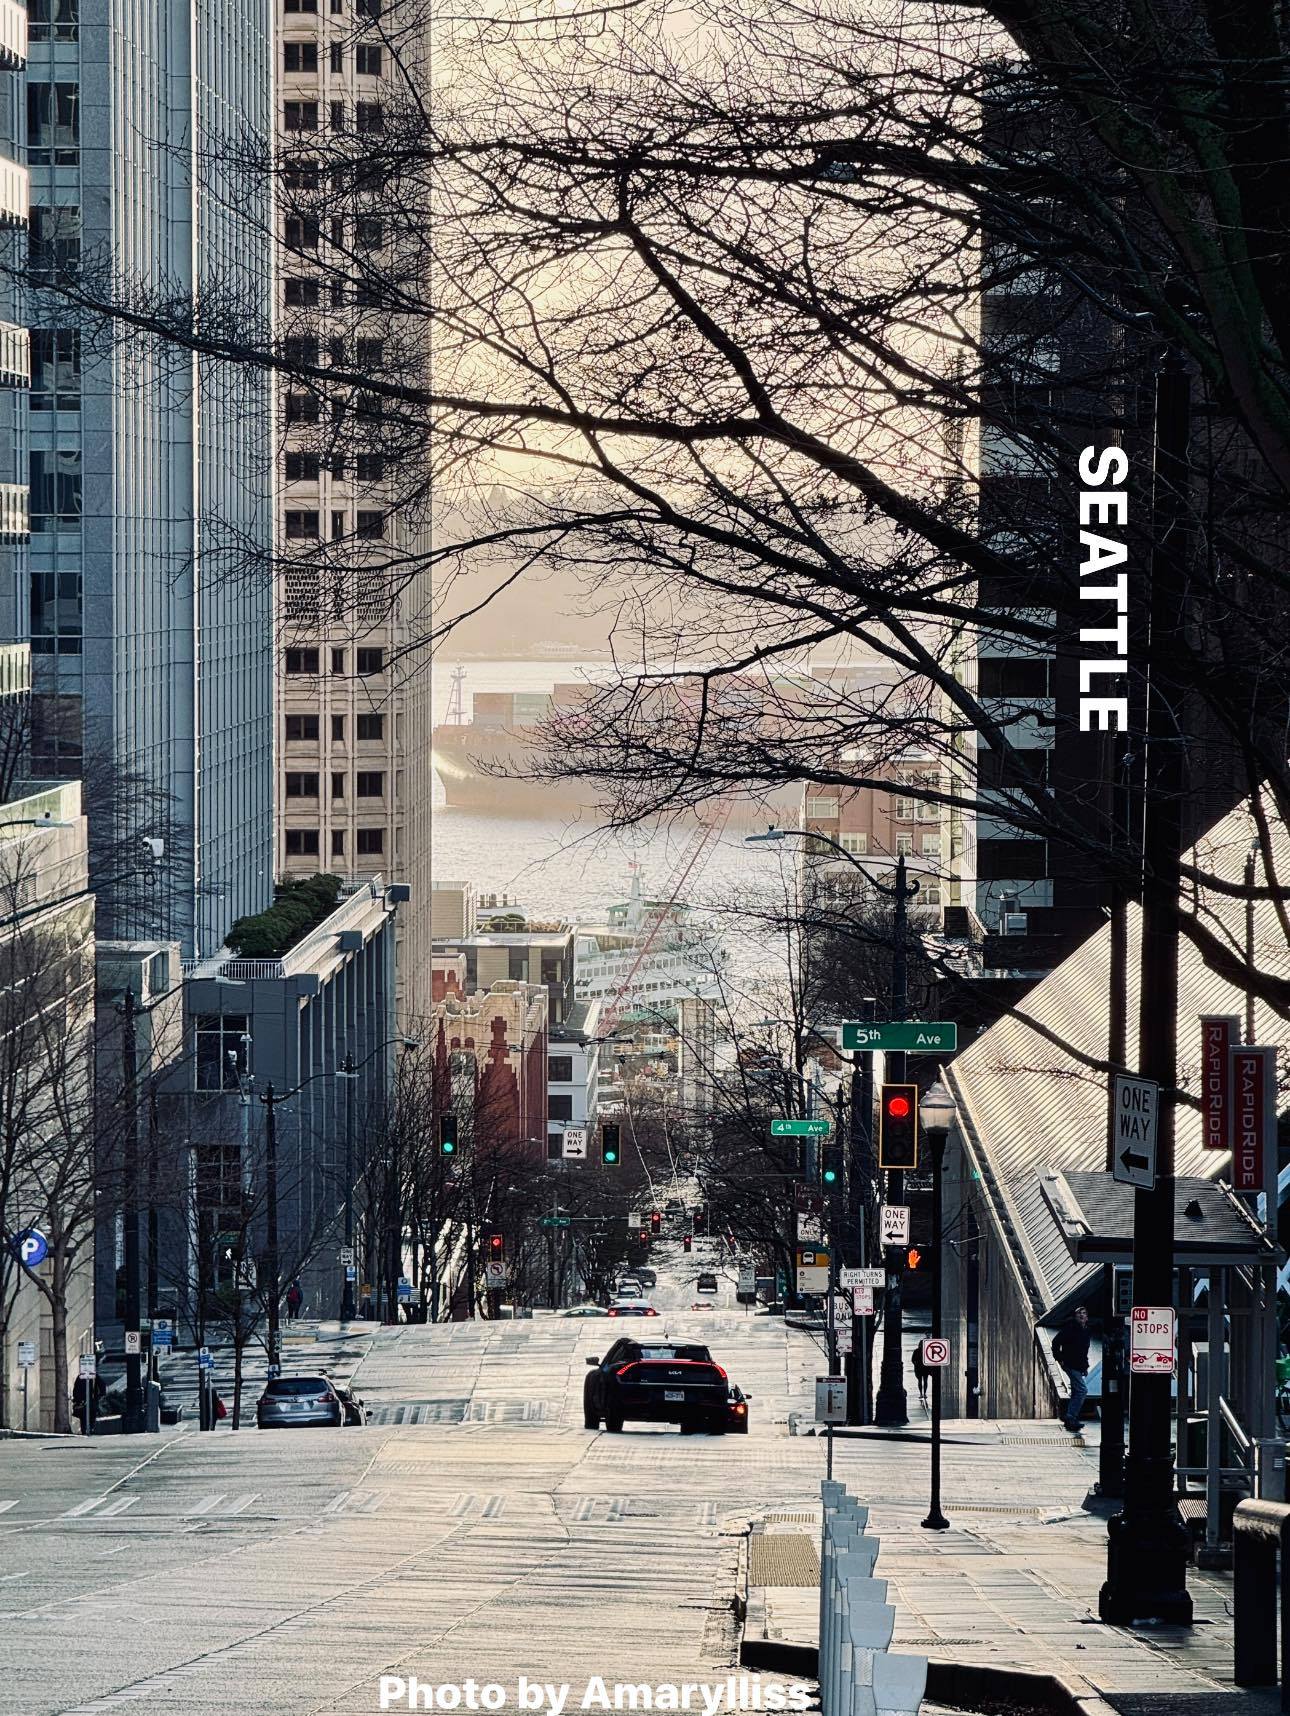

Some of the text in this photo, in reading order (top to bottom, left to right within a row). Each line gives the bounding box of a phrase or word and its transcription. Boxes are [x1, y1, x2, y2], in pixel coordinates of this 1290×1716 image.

[856, 1028, 942, 1045] 5th Ave
[1209, 1026, 1224, 1146] RAPIDRIDE
[1122, 1085, 1151, 1113] ONE
[777, 1122, 823, 1132] 4th Ave
[1120, 1113, 1151, 1141] WAY
[1242, 1059, 1257, 1186] RAPIDRIDE
[567, 1131, 583, 1139] ONE
[885, 1209, 906, 1219] ONE
[884, 1220, 906, 1229] WAY
[1133, 1310, 1147, 1320] NO
[1136, 1323, 1169, 1334] STOPS
